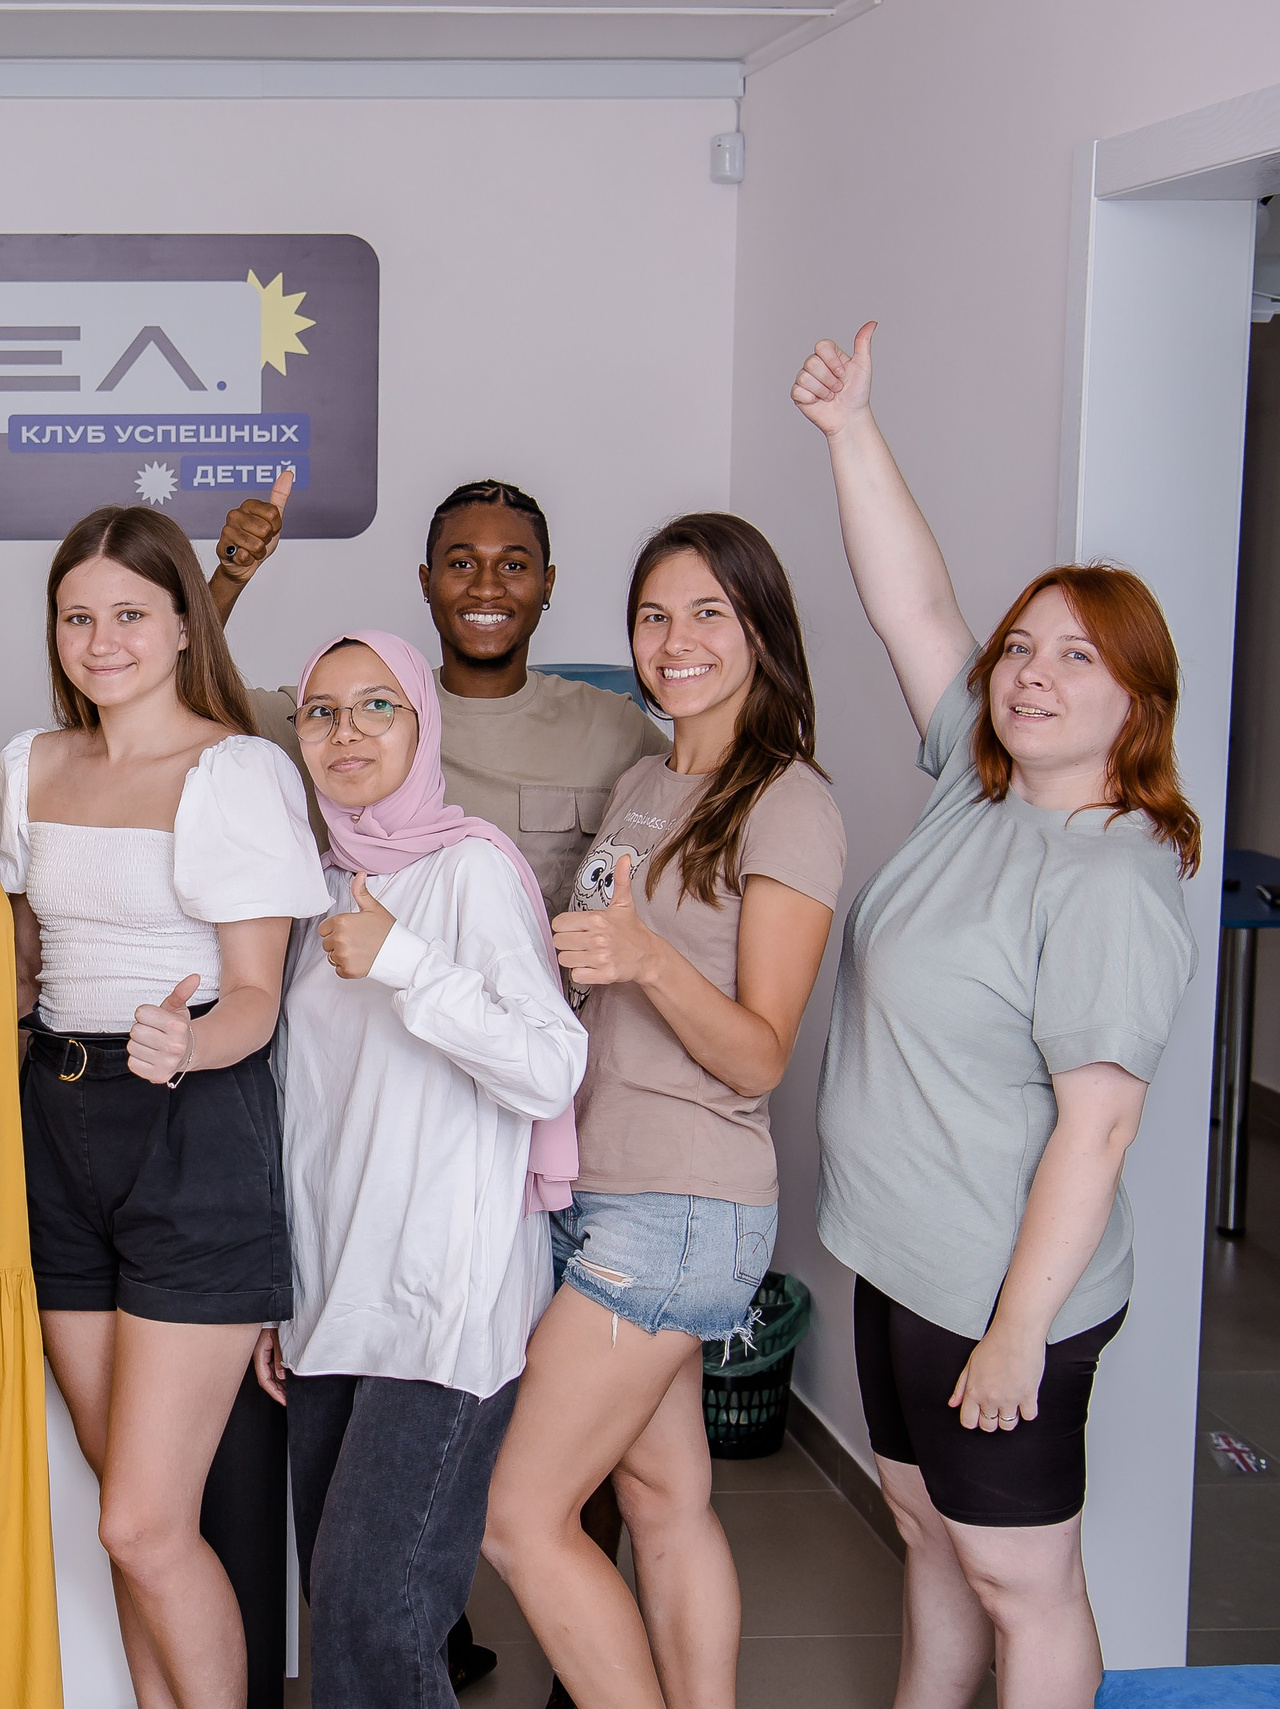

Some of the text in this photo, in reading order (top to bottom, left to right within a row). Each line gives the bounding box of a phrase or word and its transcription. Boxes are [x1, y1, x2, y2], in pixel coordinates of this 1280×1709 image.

[21, 424, 300, 444] КЛУБ УСПЕШНЫХ
[623, 808, 667, 830] happiness
